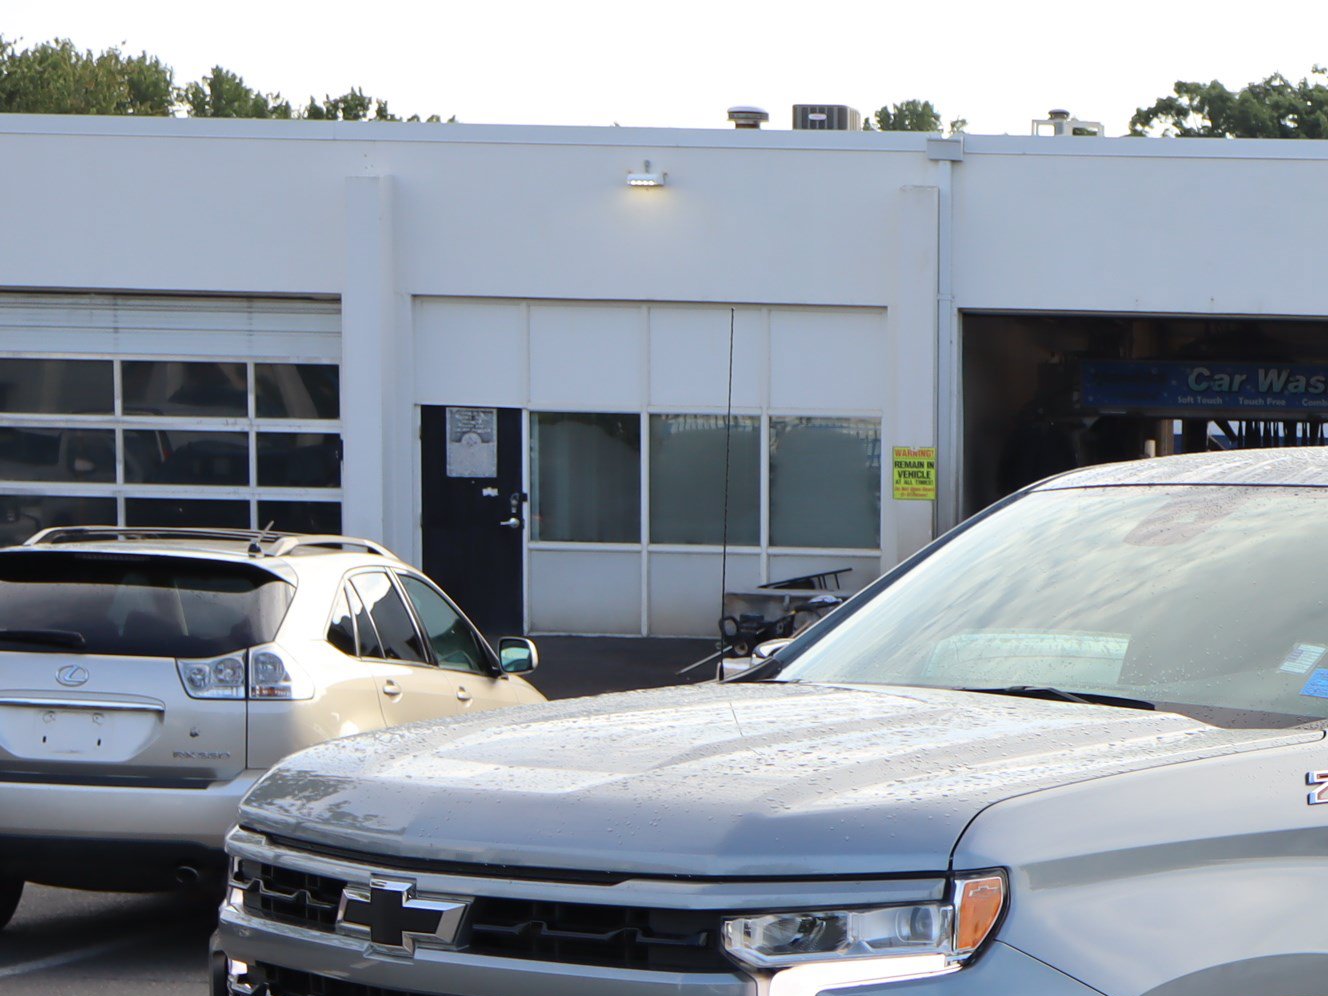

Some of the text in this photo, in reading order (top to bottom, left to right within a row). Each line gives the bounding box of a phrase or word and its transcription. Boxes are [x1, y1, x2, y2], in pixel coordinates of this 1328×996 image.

[1187, 366, 1247, 393] Car
[1177, 395, 1194, 405] Soft
[1196, 395, 1223, 406] Touch
[1238, 397, 1265, 407] Touch
[1266, 397, 1286, 407] Free
[894, 460, 935, 469] REMAIN IN
[897, 470, 931, 479] VEHICLE
